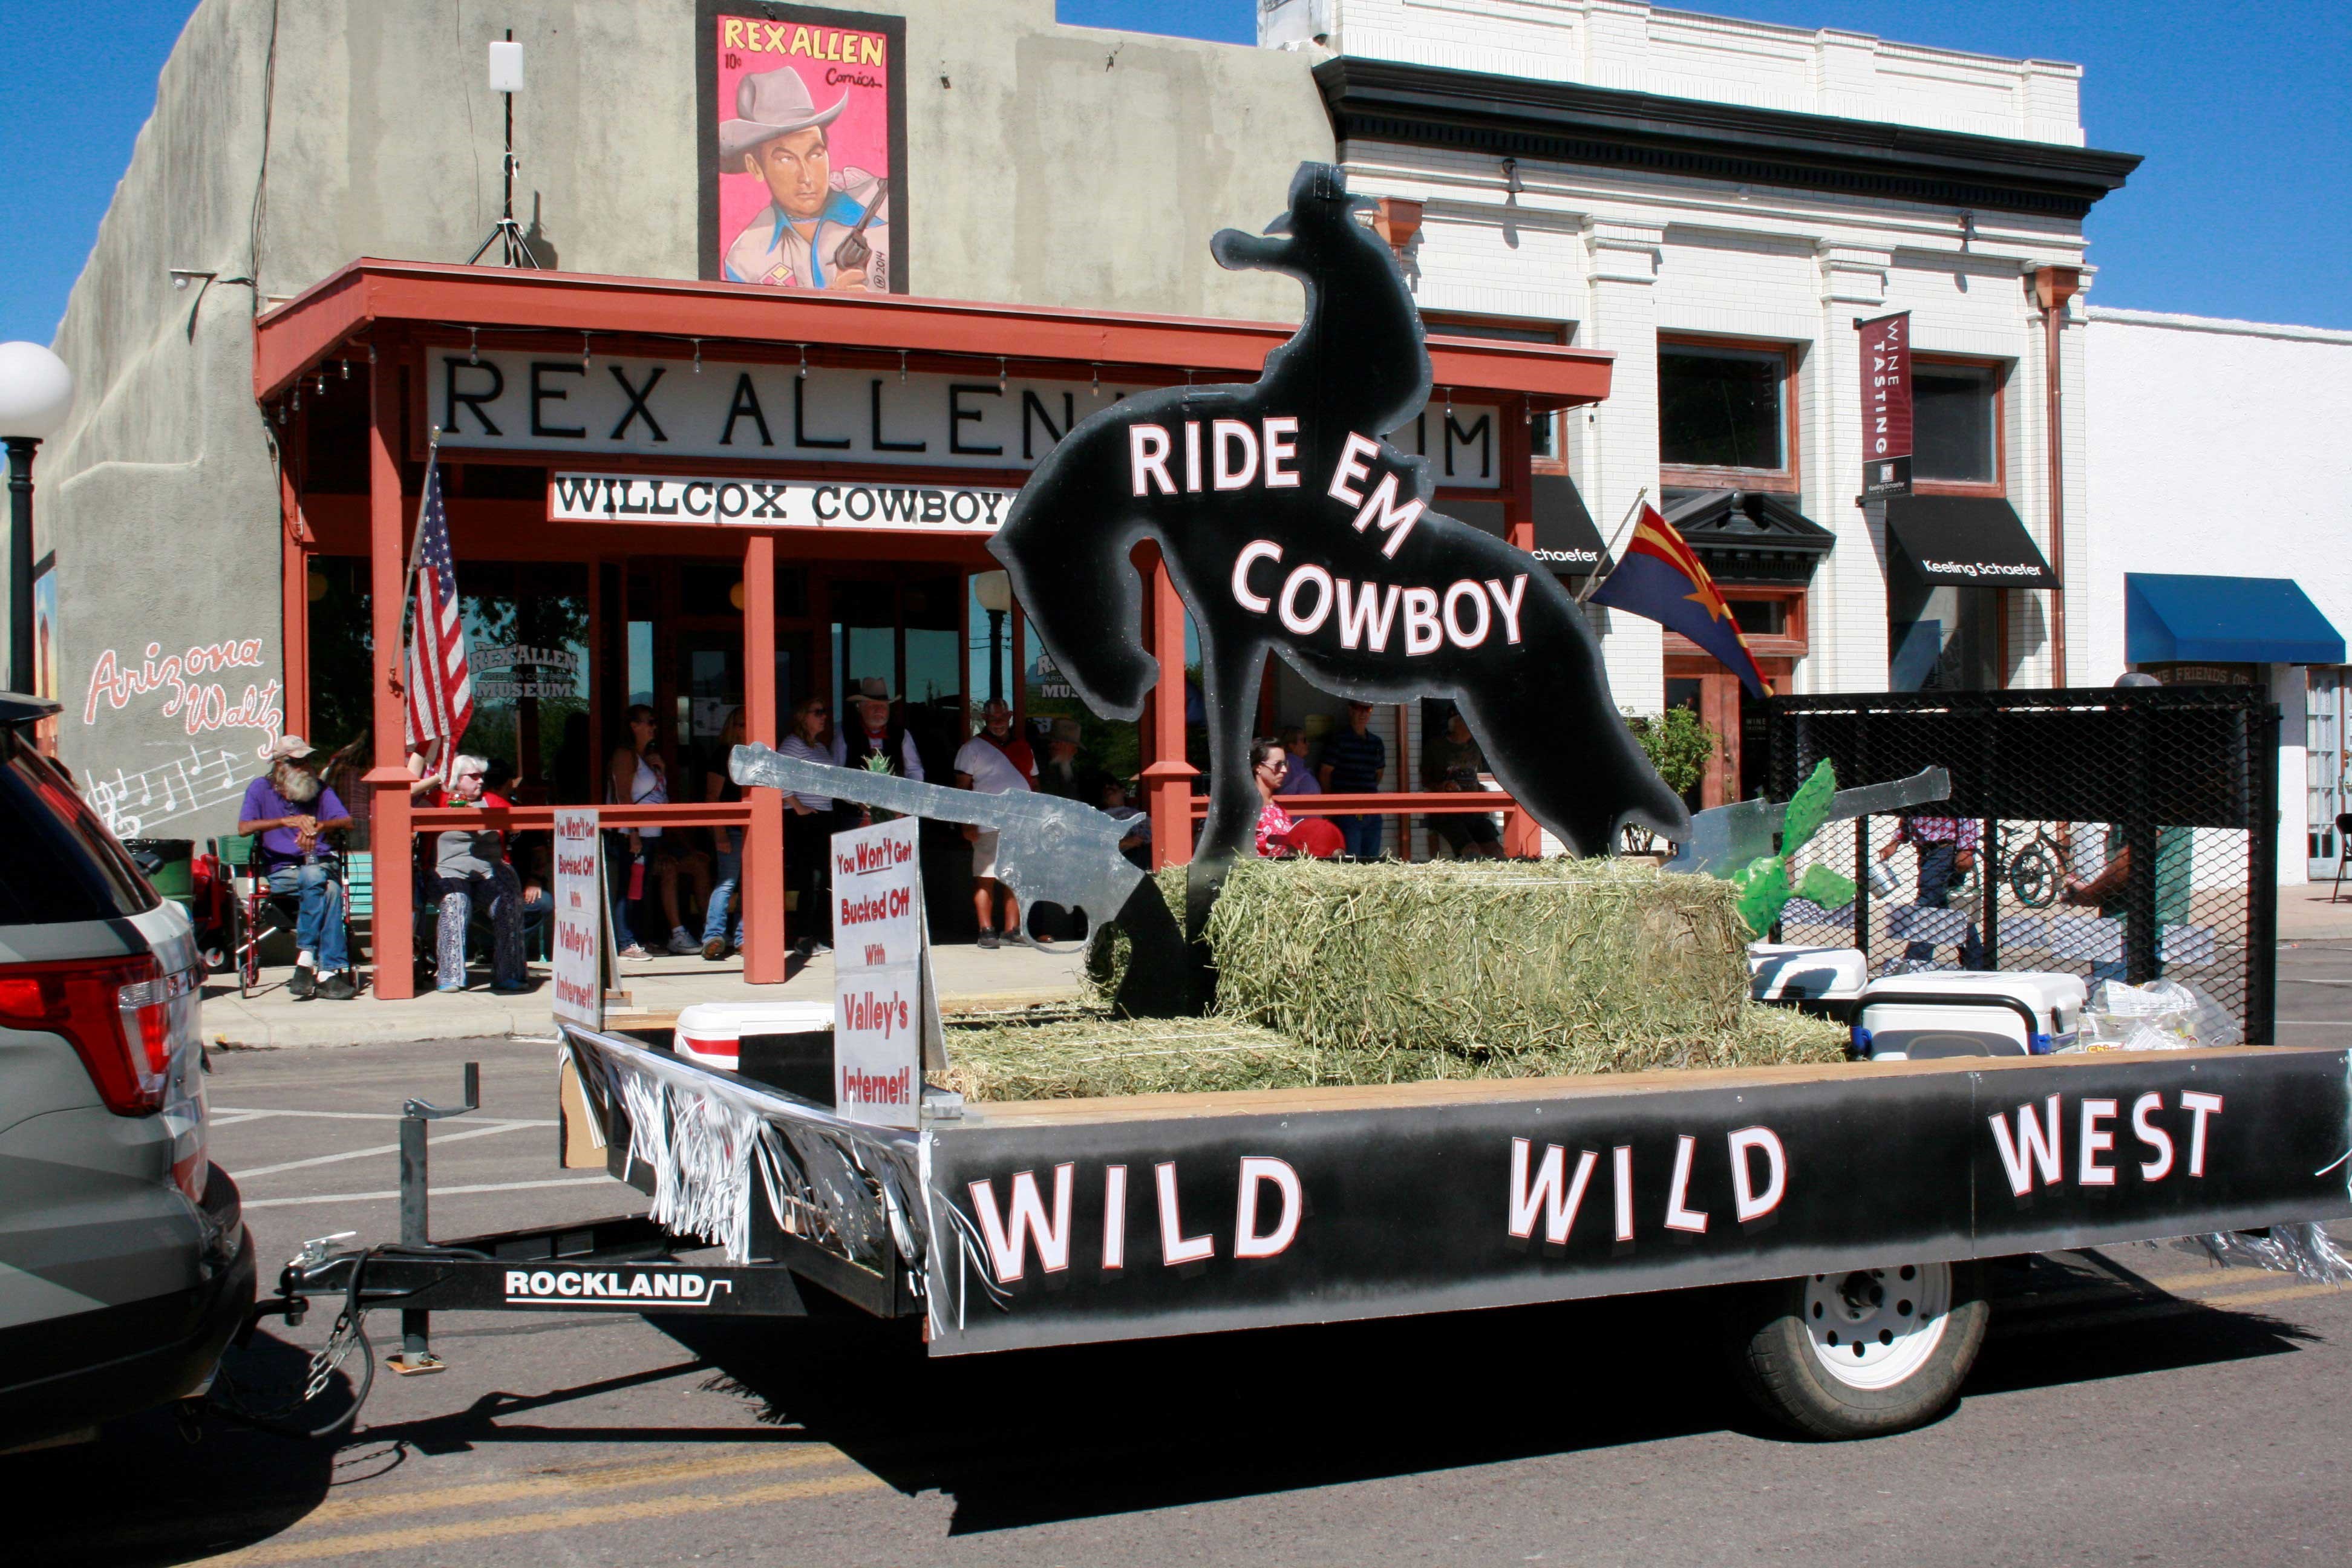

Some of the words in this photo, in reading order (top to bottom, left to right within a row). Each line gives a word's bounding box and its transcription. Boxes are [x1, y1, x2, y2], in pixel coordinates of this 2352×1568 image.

[725, 19, 786, 55] REX
[790, 26, 884, 67] ALLEN
[826, 68, 883, 88] Comics
[876, 250, 886, 275] 2014
[1887, 320, 1899, 385] WINE
[442, 356, 668, 442] REX
[719, 372, 1074, 460] ALLEN
[1874, 341, 1887, 454] TASTING
[556, 477, 787, 520] WILLCOX
[812, 485, 1002, 525] COWBOY
[1129, 417, 1301, 497] RIDE
[1328, 431, 1426, 560] EM
[1531, 546, 1598, 563] chaefer
[1922, 560, 1978, 577] Keeling
[1976, 562, 2042, 576] Schaefer
[1232, 540, 1528, 657] COWBOY
[469, 647, 515, 675] REX
[516, 644, 578, 673] ALLEN
[84, 638, 264, 725] Arizona
[476, 682, 572, 697] MUSEUM
[186, 678, 283, 760] Waltz
[583, 855, 594, 877] Off
[837, 854, 855, 875] You
[855, 837, 892, 871] Won't
[894, 840, 912, 864] Get
[841, 890, 887, 926] Bucked
[889, 886, 910, 918] Off
[560, 920, 593, 961] Valley's
[865, 944, 886, 966] With
[557, 972, 594, 1011] Internet!
[843, 990, 909, 1040] Valley's
[843, 1066, 910, 1105] Internet!
[968, 1155, 1302, 1284] WILD
[1508, 1125, 1788, 1245] WILD
[1988, 1089, 2225, 1197] WEST
[505, 1271, 705, 1298] ROCKLAND
